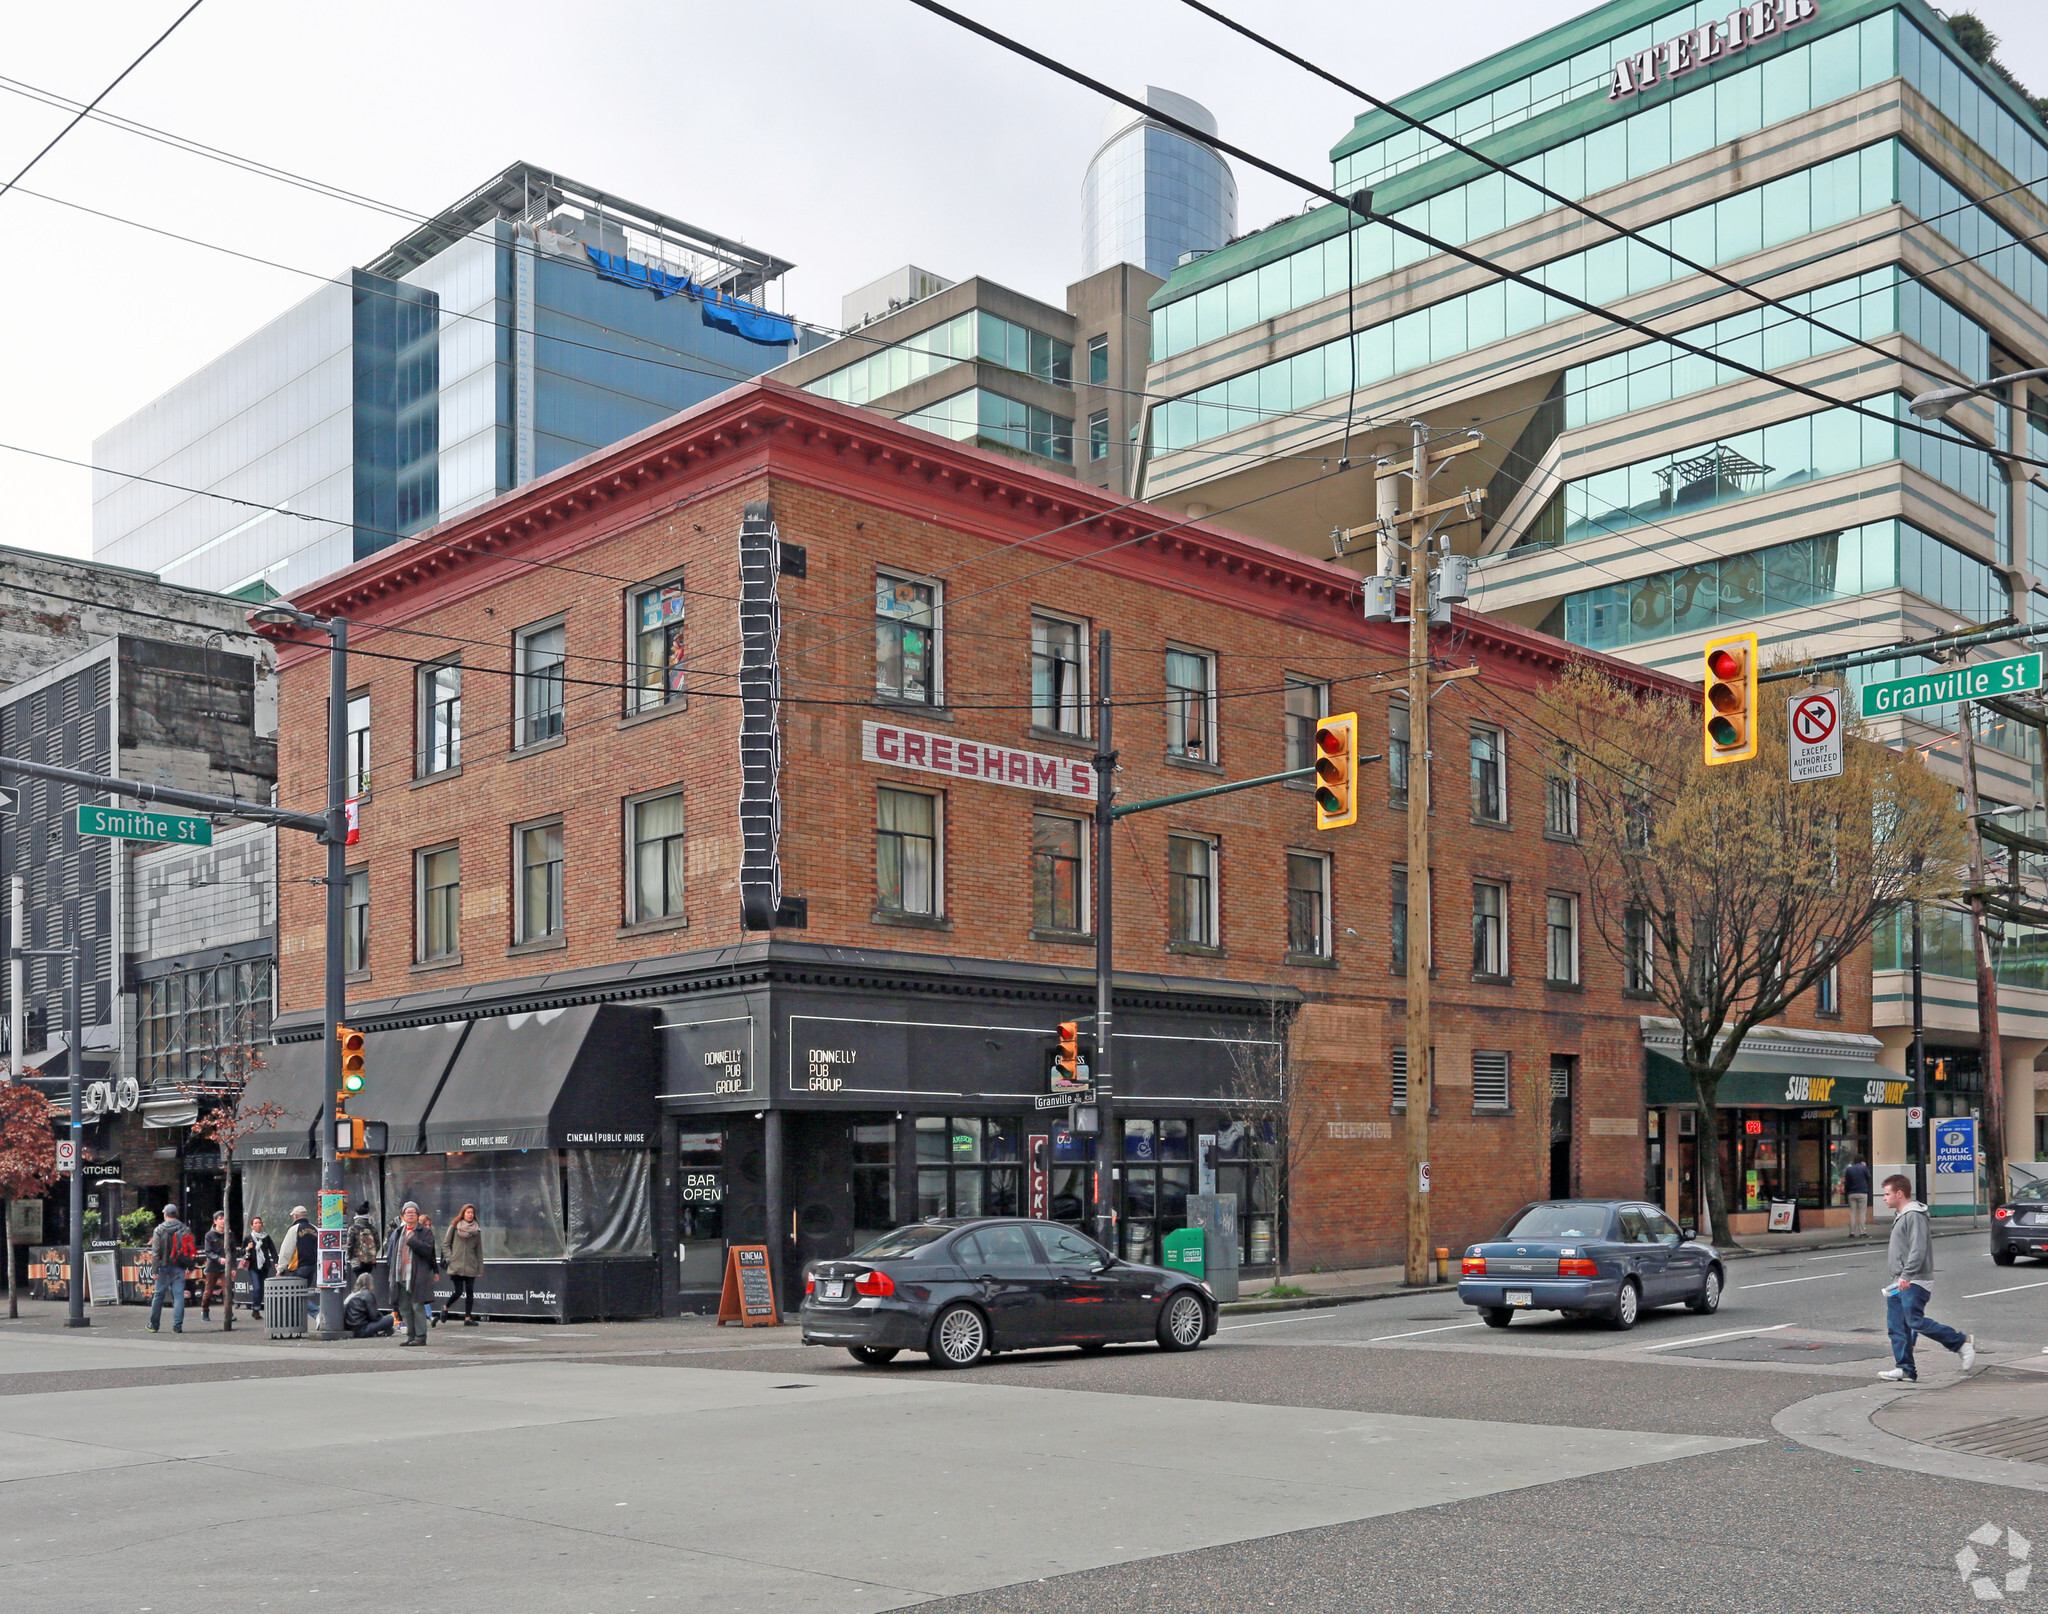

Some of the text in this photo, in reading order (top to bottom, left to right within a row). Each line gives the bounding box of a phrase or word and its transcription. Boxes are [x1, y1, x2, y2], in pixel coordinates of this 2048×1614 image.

[1608, 0, 1816, 99] ATELIER
[1876, 662, 2025, 711] Granville St
[1801, 744, 1828, 757] EXCEPT
[876, 727, 1090, 794] GRESHAM'S
[1793, 752, 1838, 767] AUTHORIZED
[1799, 762, 1833, 776] VEHICLES
[95, 811, 196, 840] Smithe St
[704, 1049, 742, 1066] DONNELLY
[809, 1049, 857, 1064] DONNELLY
[725, 1064, 741, 1078] PUB
[809, 1064, 829, 1077] PUB
[715, 1078, 742, 1094] GROUP
[809, 1077, 843, 1092] GROUP
[1785, 1076, 1909, 1105] SUBWAY SUBWAY
[1038, 1094, 1072, 1107] Granville
[1801, 1109, 1839, 1120] SUBWAY
[1746, 1121, 1761, 1133] OPEN
[462, 1135, 508, 1146] CINEMA PUBLIC HOUSE
[567, 1133, 645, 1142] CINEMA PUBLIC HOUSE
[1937, 1154, 1972, 1162] PARKING
[687, 1174, 715, 1186] BAR
[683, 1188, 721, 1200] OPEN
[740, 1251, 763, 1260] CINEMA
